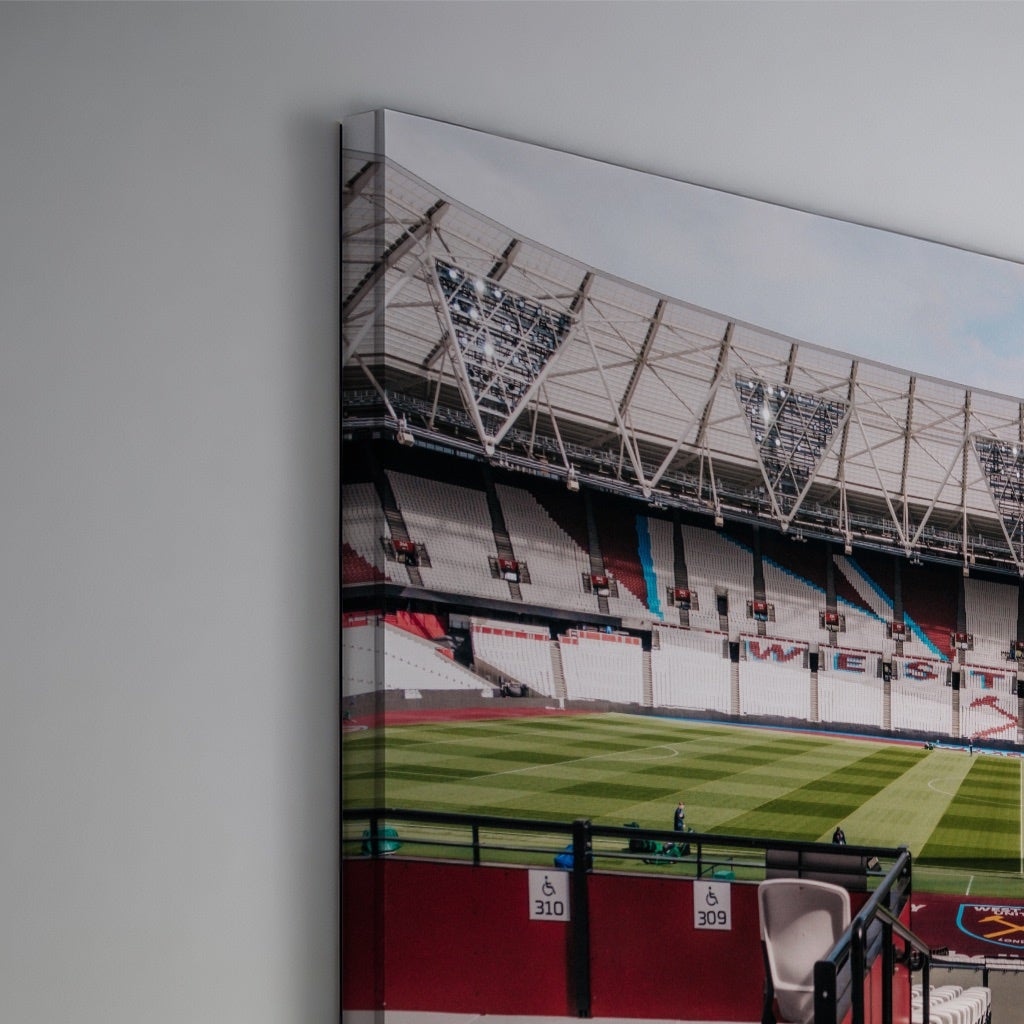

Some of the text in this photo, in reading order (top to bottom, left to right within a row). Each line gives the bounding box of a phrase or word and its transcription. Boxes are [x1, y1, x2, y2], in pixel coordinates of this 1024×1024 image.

[745, 640, 1005, 690] WEST
[534, 900, 564, 916] 310
[697, 910, 727, 926] 309
